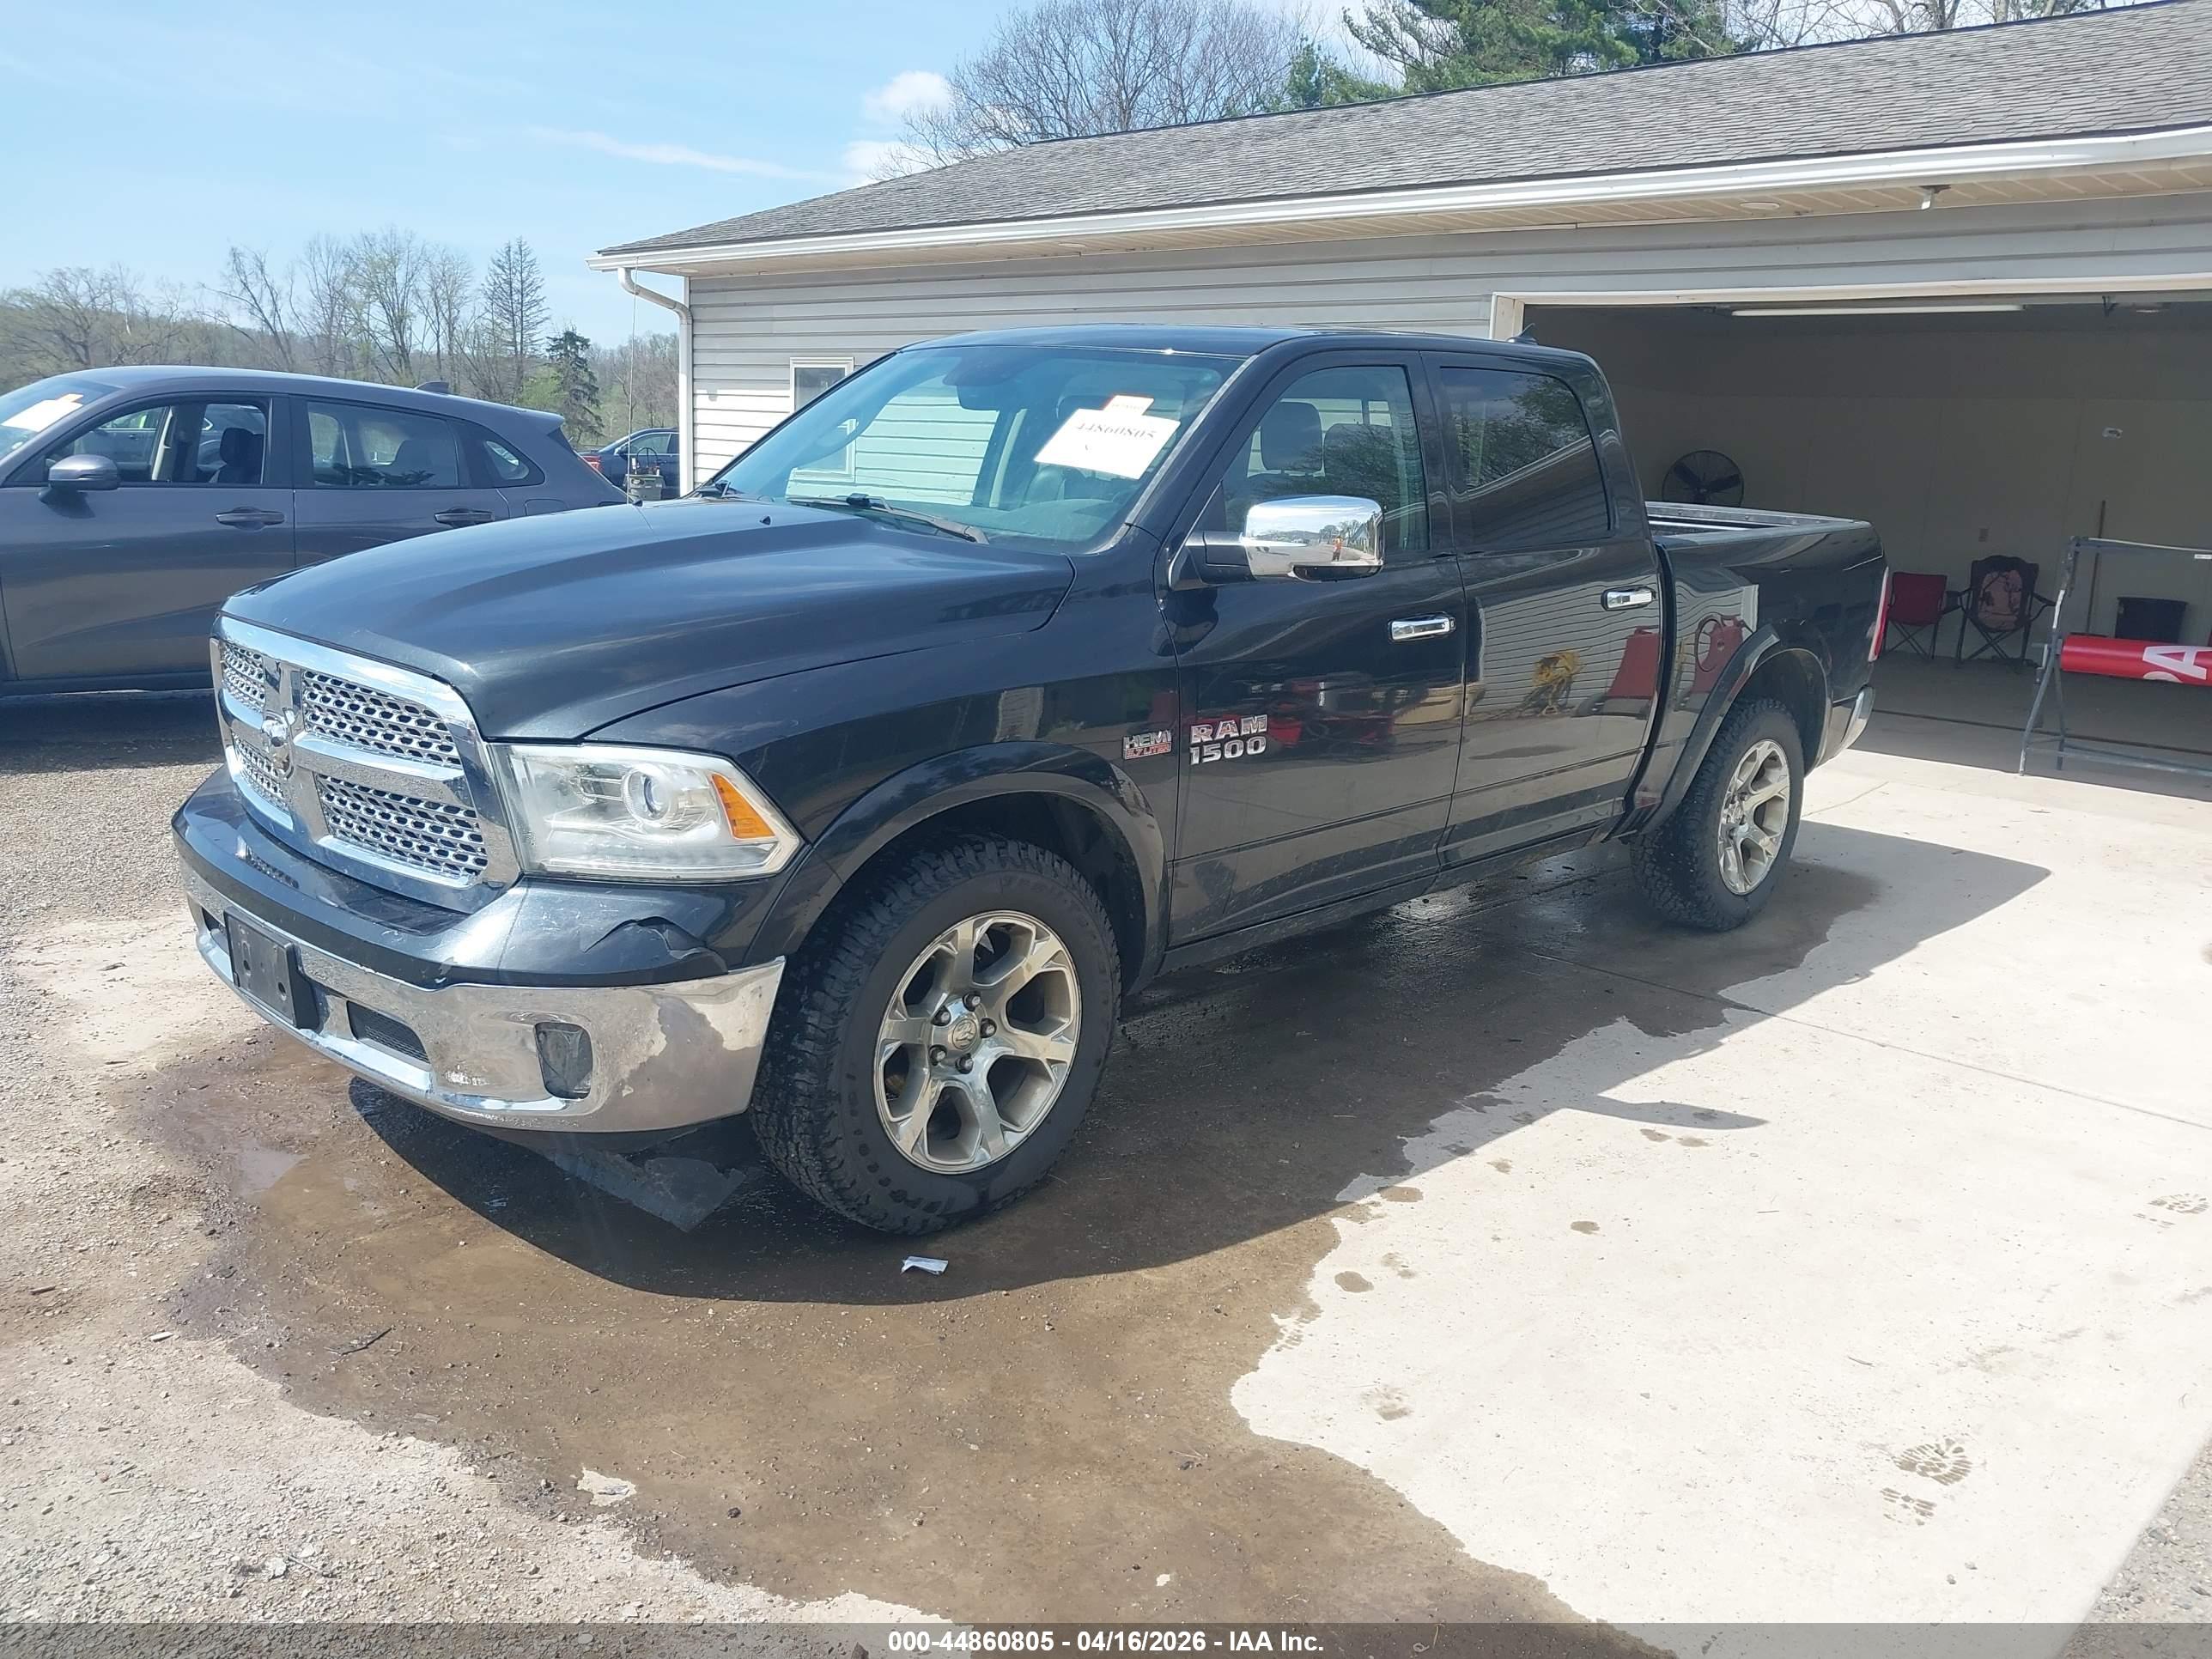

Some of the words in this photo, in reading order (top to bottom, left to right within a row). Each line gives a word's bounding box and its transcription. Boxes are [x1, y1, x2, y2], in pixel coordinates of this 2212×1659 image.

[1123, 730, 1172, 749] HEMI
[1190, 714, 1267, 744] RAM
[1143, 743, 1170, 755] LITER
[1189, 736, 1267, 765] 1500
